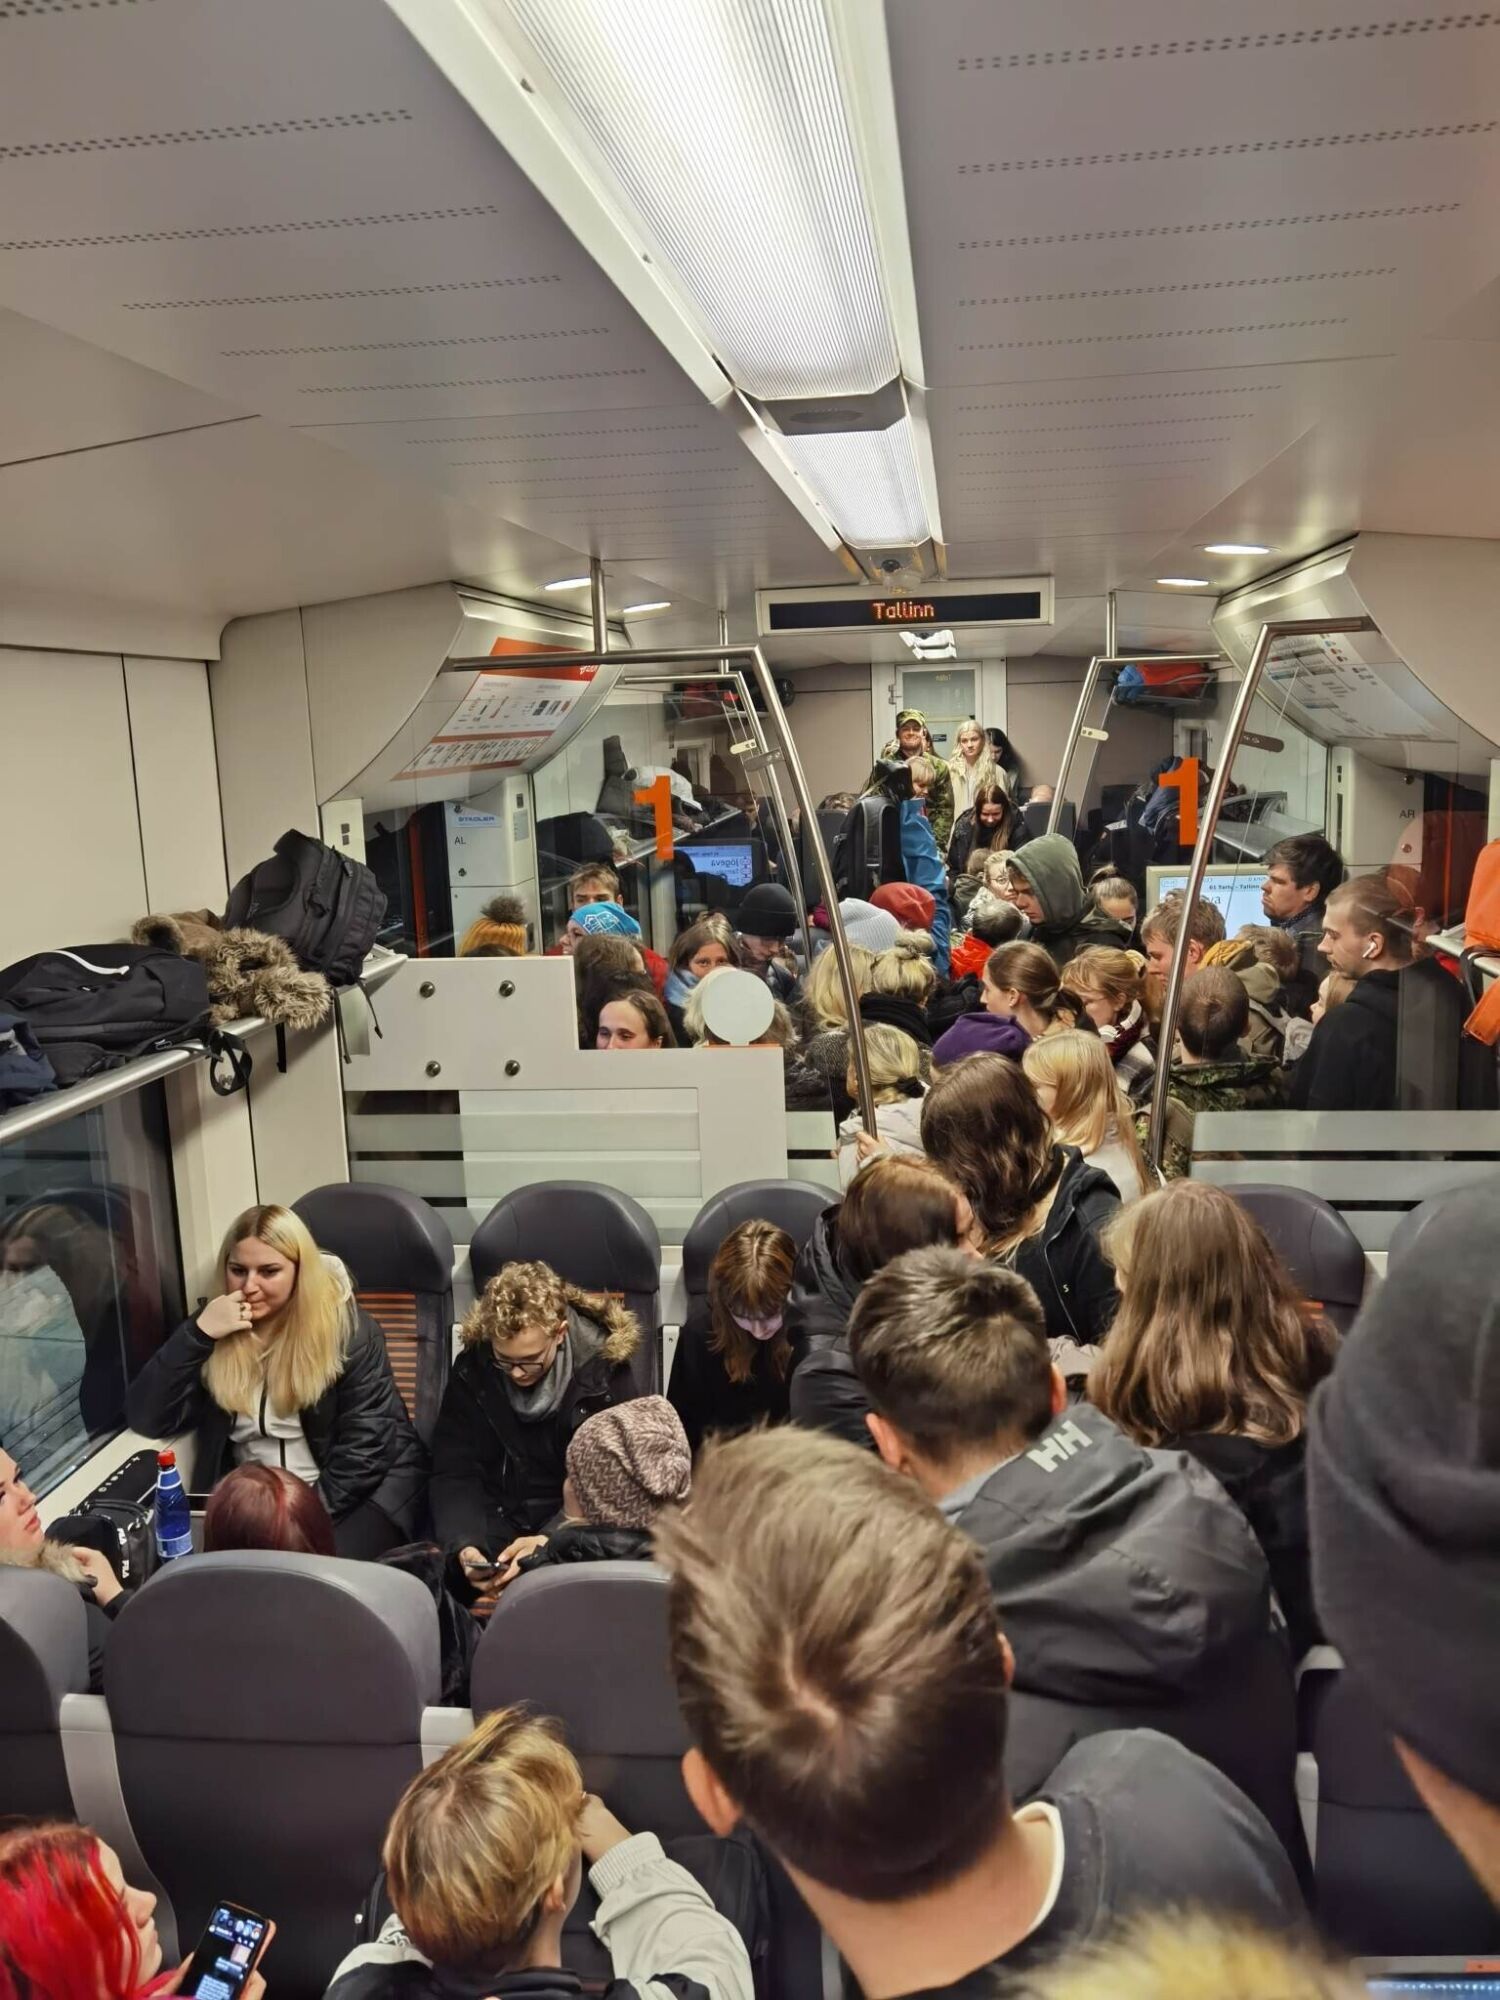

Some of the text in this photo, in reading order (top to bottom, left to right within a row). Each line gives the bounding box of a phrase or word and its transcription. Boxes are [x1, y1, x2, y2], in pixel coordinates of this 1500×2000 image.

[873, 601, 935, 619] Tallinn
[633, 774, 675, 860] 1
[1158, 757, 1199, 846] 1
[454, 835, 466, 845] AL
[1026, 1419, 1093, 1473] HH
